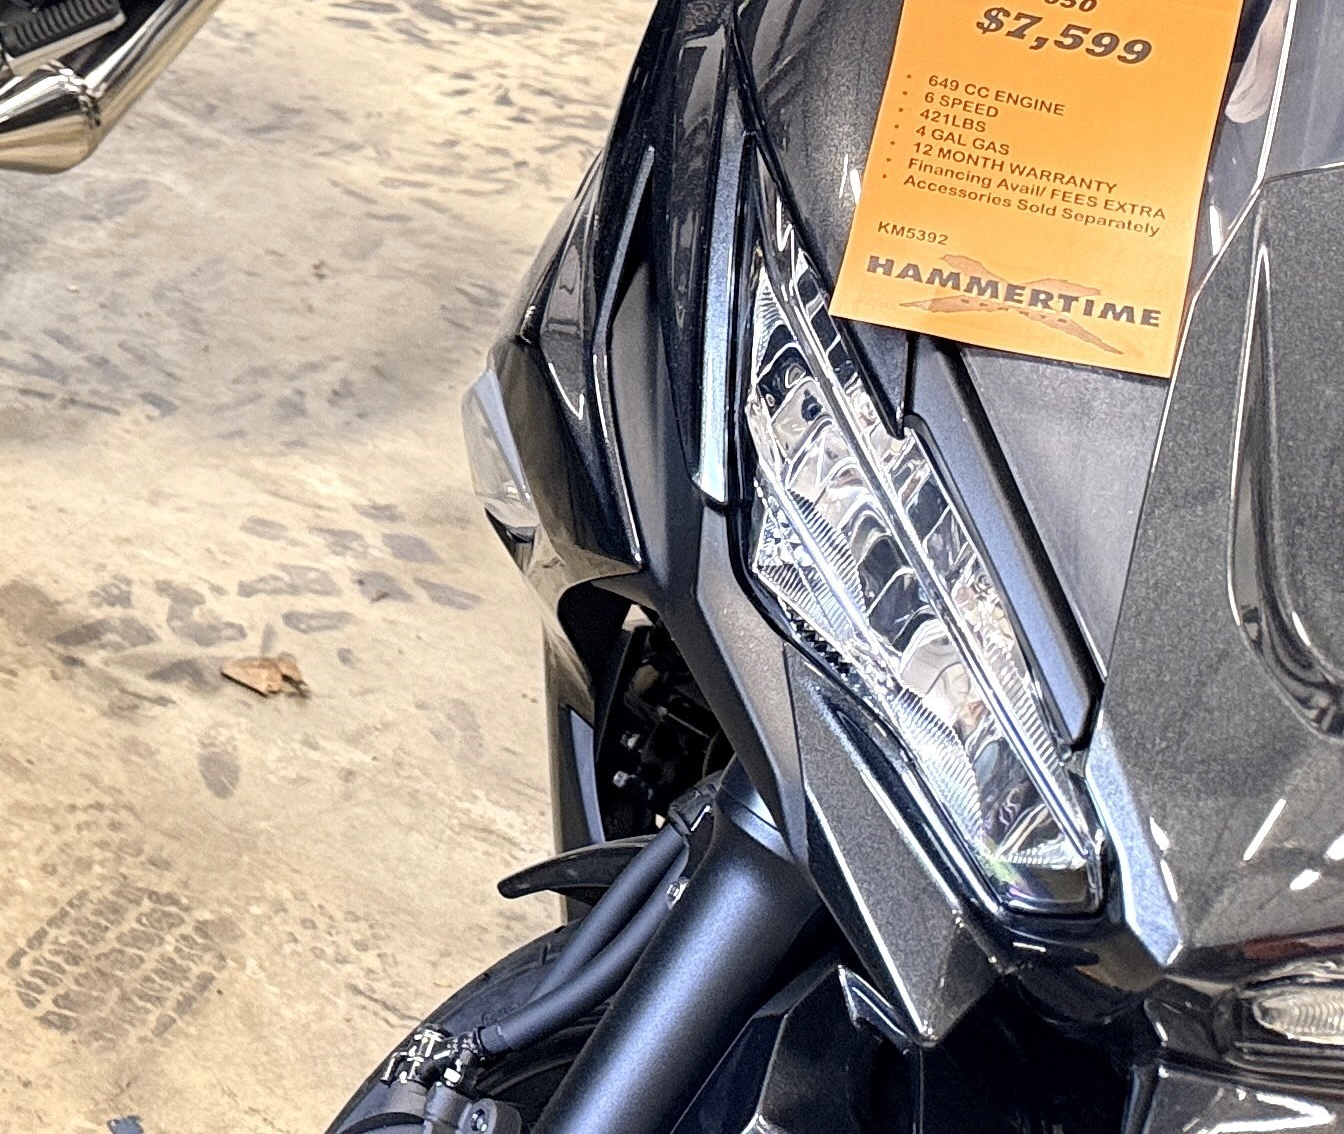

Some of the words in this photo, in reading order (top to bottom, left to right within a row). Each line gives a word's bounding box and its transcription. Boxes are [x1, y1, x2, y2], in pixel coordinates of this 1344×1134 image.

[975, 6, 1153, 65] $7,599
[924, 91, 935, 104] 6
[938, 96, 999, 118] SPEED
[928, 74, 960, 92] 649
[964, 82, 990, 99] CC
[994, 90, 1067, 117] ENGINE
[915, 125, 926, 138] 4
[930, 128, 968, 147] GAL
[972, 137, 1010, 156] GAS
[919, 108, 987, 133] 421LBS
[908, 157, 993, 189] Financing
[997, 177, 1047, 198] Avail/
[1050, 188, 1099, 208] FEES
[1103, 200, 1166, 220] EXTRA
[912, 142, 933, 157] 12
[937, 147, 1005, 172] MONTH
[1010, 163, 1118, 194] WARRANTY
[903, 174, 1012, 208] Accessories
[1016, 198, 1058, 217] Sold
[1061, 207, 1160, 238] Separately
[877, 221, 949, 246] KM5392
[866, 255, 1162, 328] HAMMERTIME
